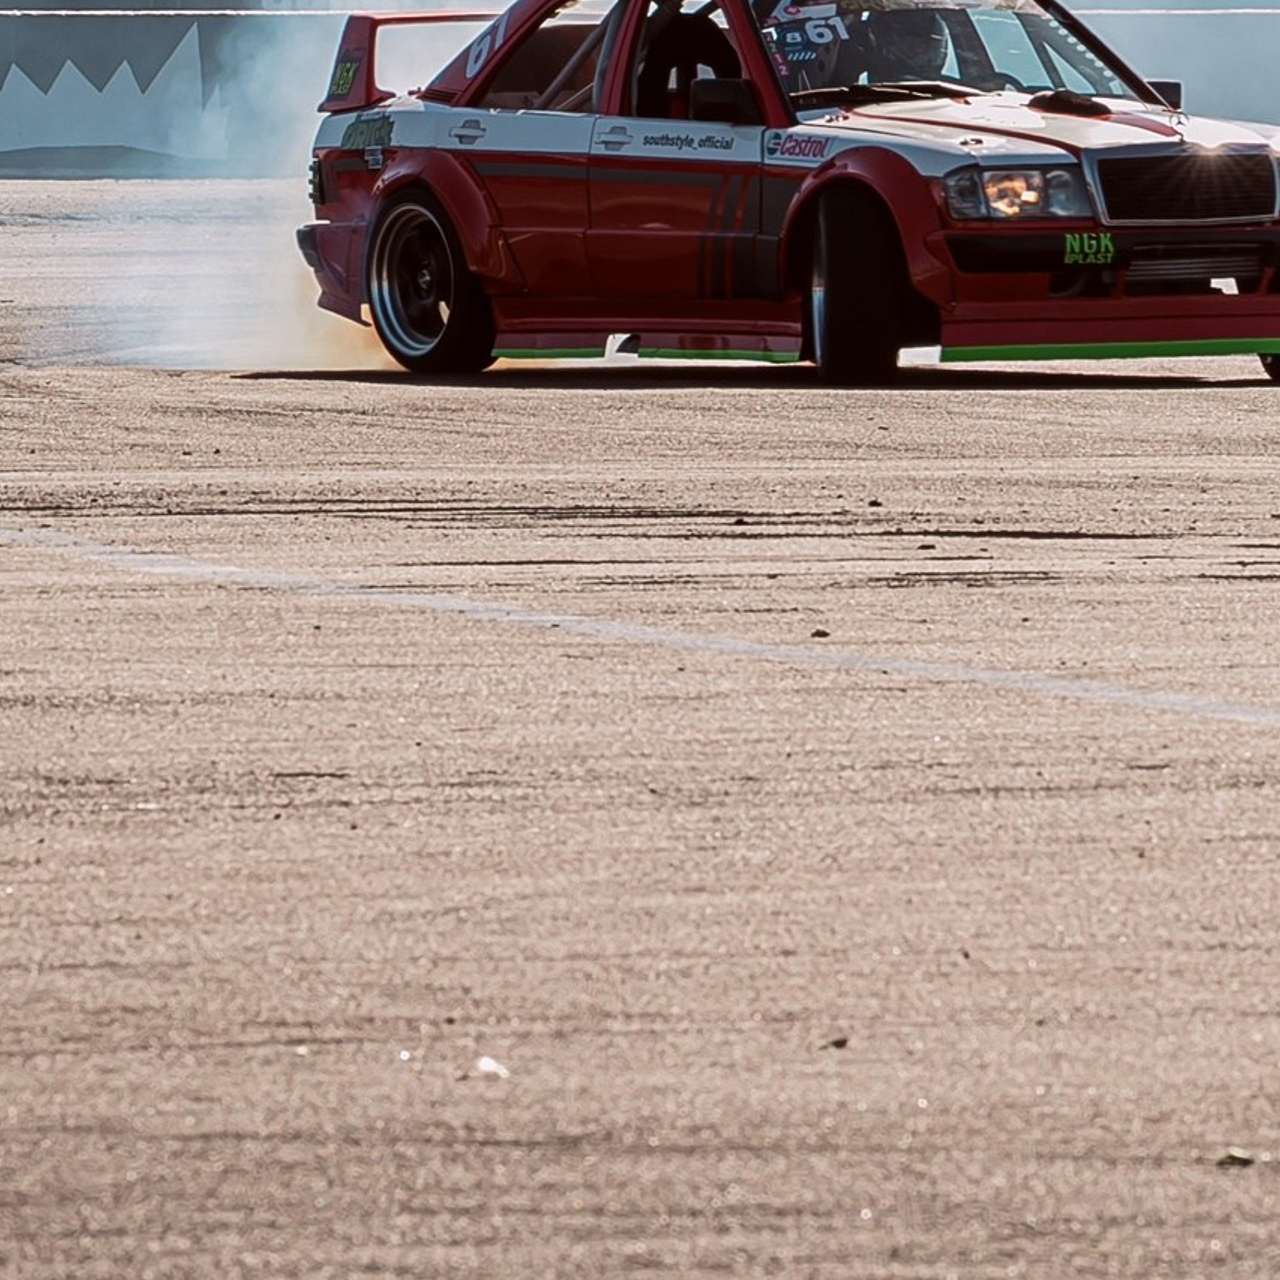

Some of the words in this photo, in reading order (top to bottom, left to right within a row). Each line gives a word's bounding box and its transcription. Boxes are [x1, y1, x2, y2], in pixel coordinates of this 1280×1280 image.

[805, 17, 850, 44] 61
[642, 133, 735, 151] southstyle_official
[780, 134, 830, 158] Castrol
[1065, 232, 1115, 255] NGK
